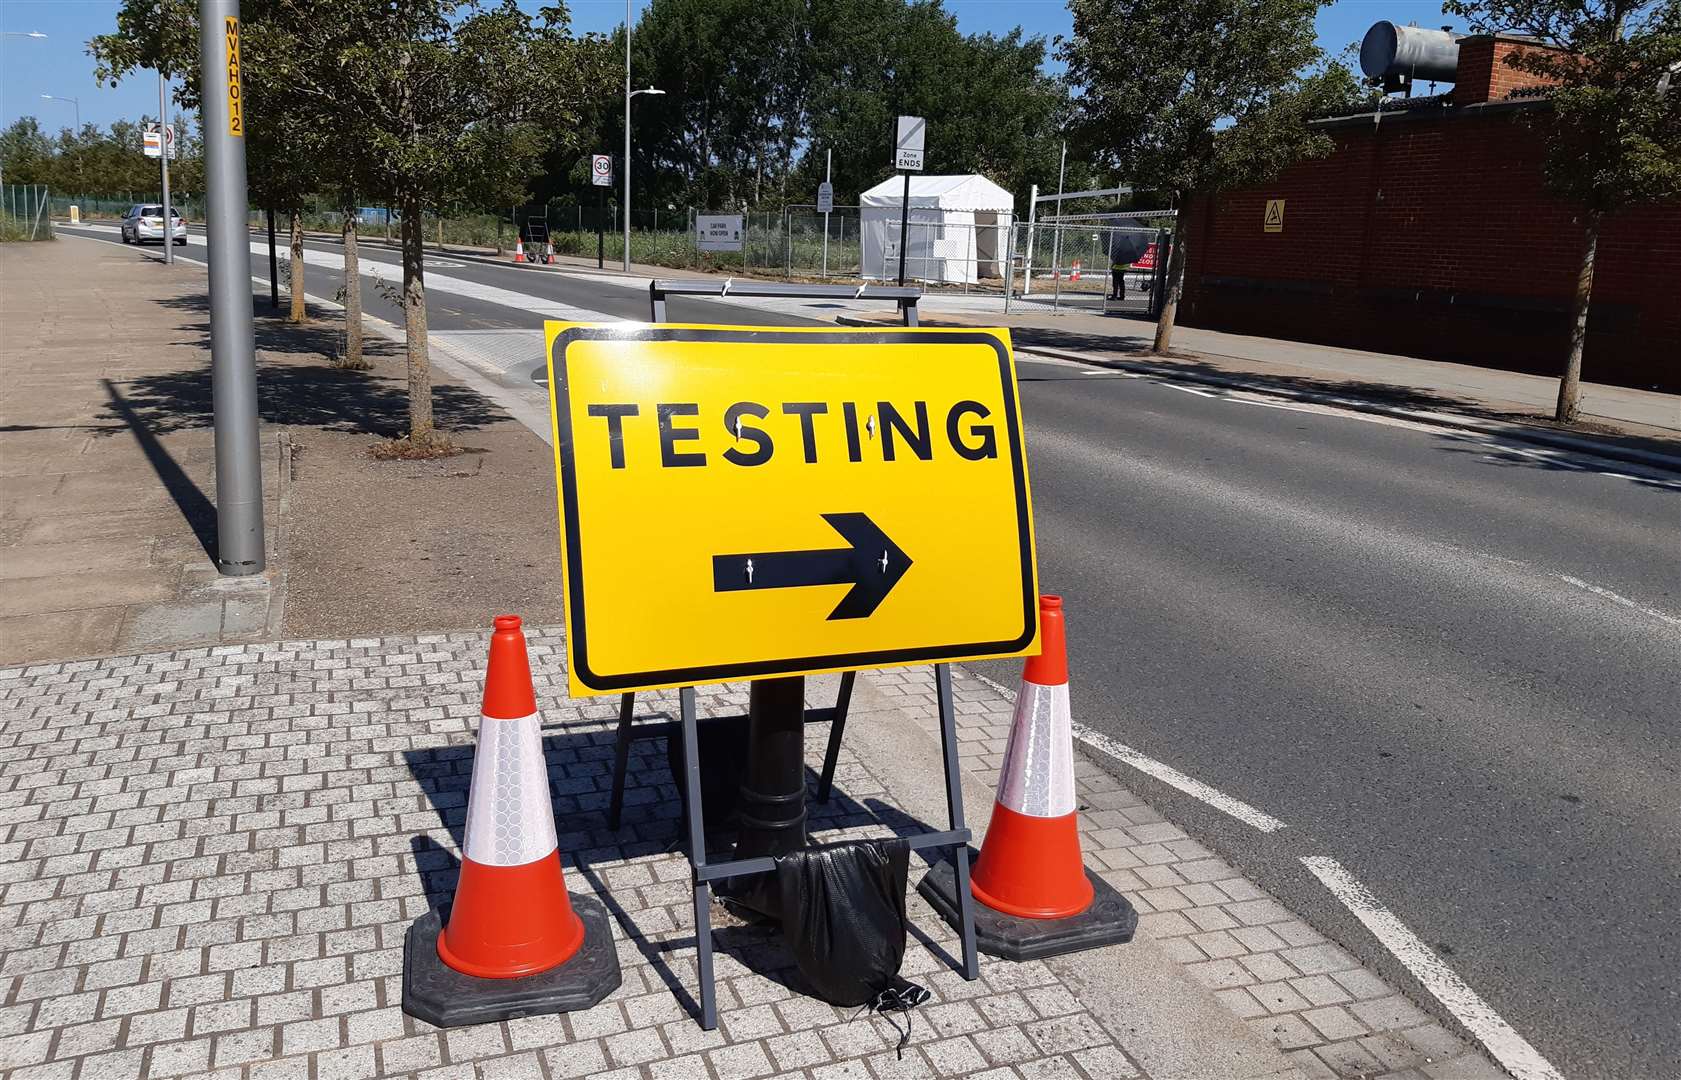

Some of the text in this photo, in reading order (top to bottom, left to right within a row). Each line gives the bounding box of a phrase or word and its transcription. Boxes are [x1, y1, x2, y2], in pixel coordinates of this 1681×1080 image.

[596, 161, 609, 170] 30
[898, 159, 921, 167] ENDS
[587, 400, 998, 469] TESTING
